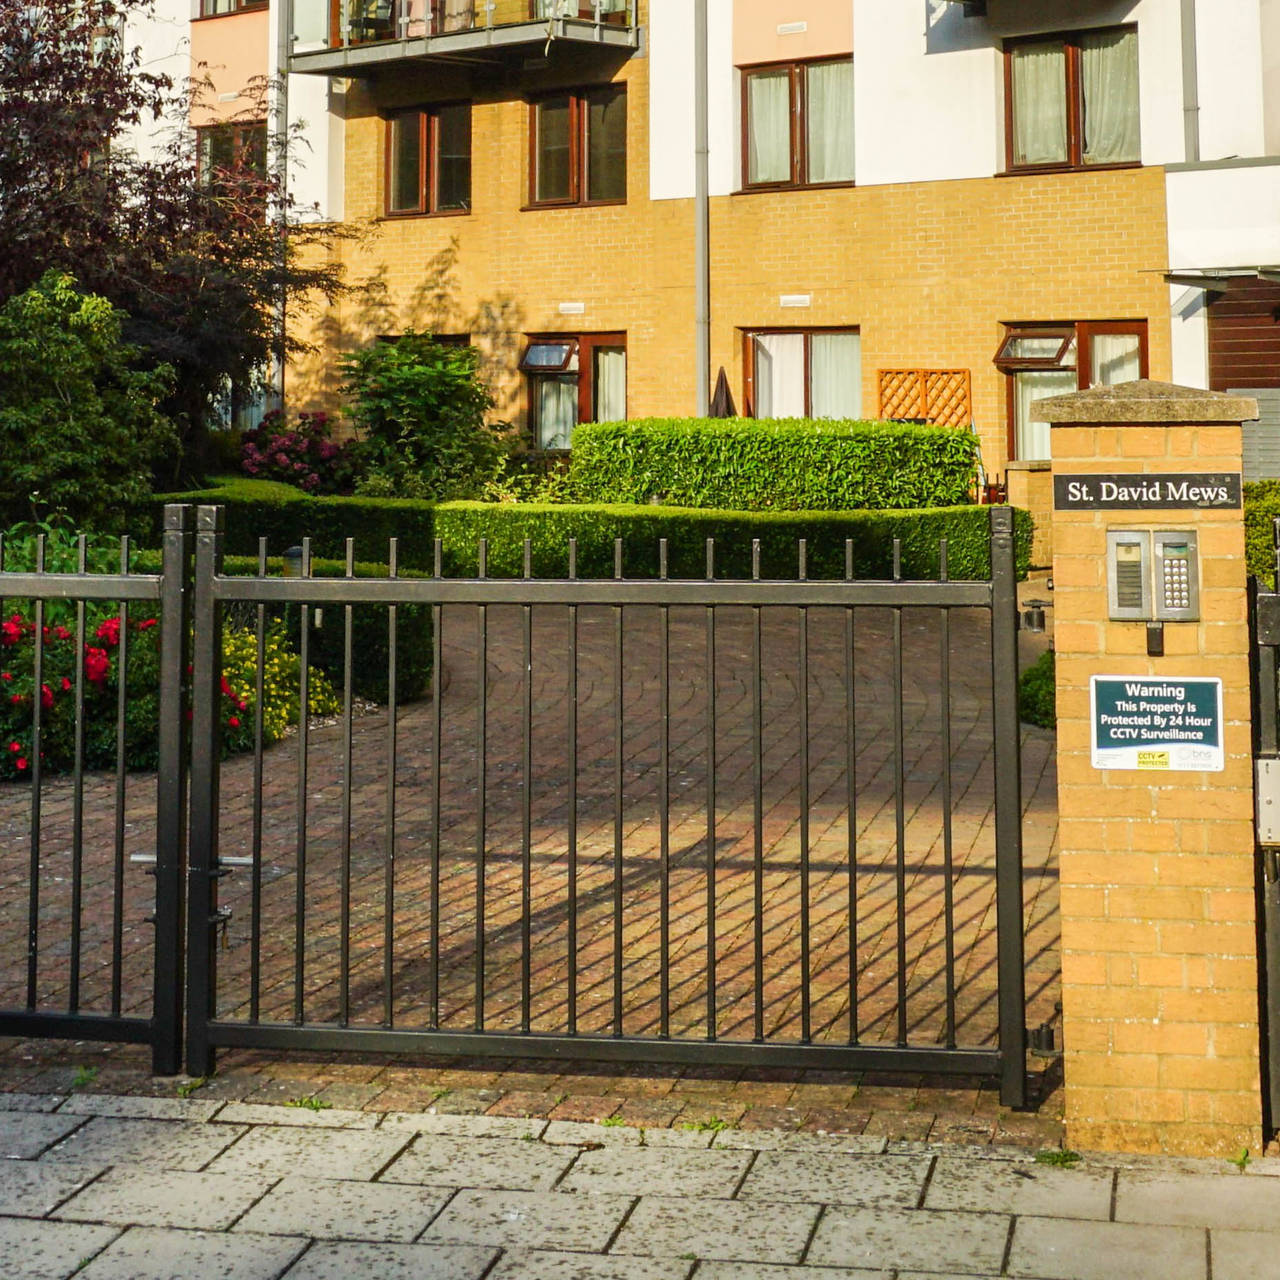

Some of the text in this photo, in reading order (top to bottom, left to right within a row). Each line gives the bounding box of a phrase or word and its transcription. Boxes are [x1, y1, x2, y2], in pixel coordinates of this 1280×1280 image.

[1067, 480, 1228, 502] St. David Mews
[1125, 683, 1185, 700] Warning
[1115, 701, 1196, 714] This Property Is
[1100, 714, 1212, 728] Protected By 24 Hour
[1109, 728, 1204, 740] CCTV Surveillance
[1137, 752, 1156, 760] CCTV
